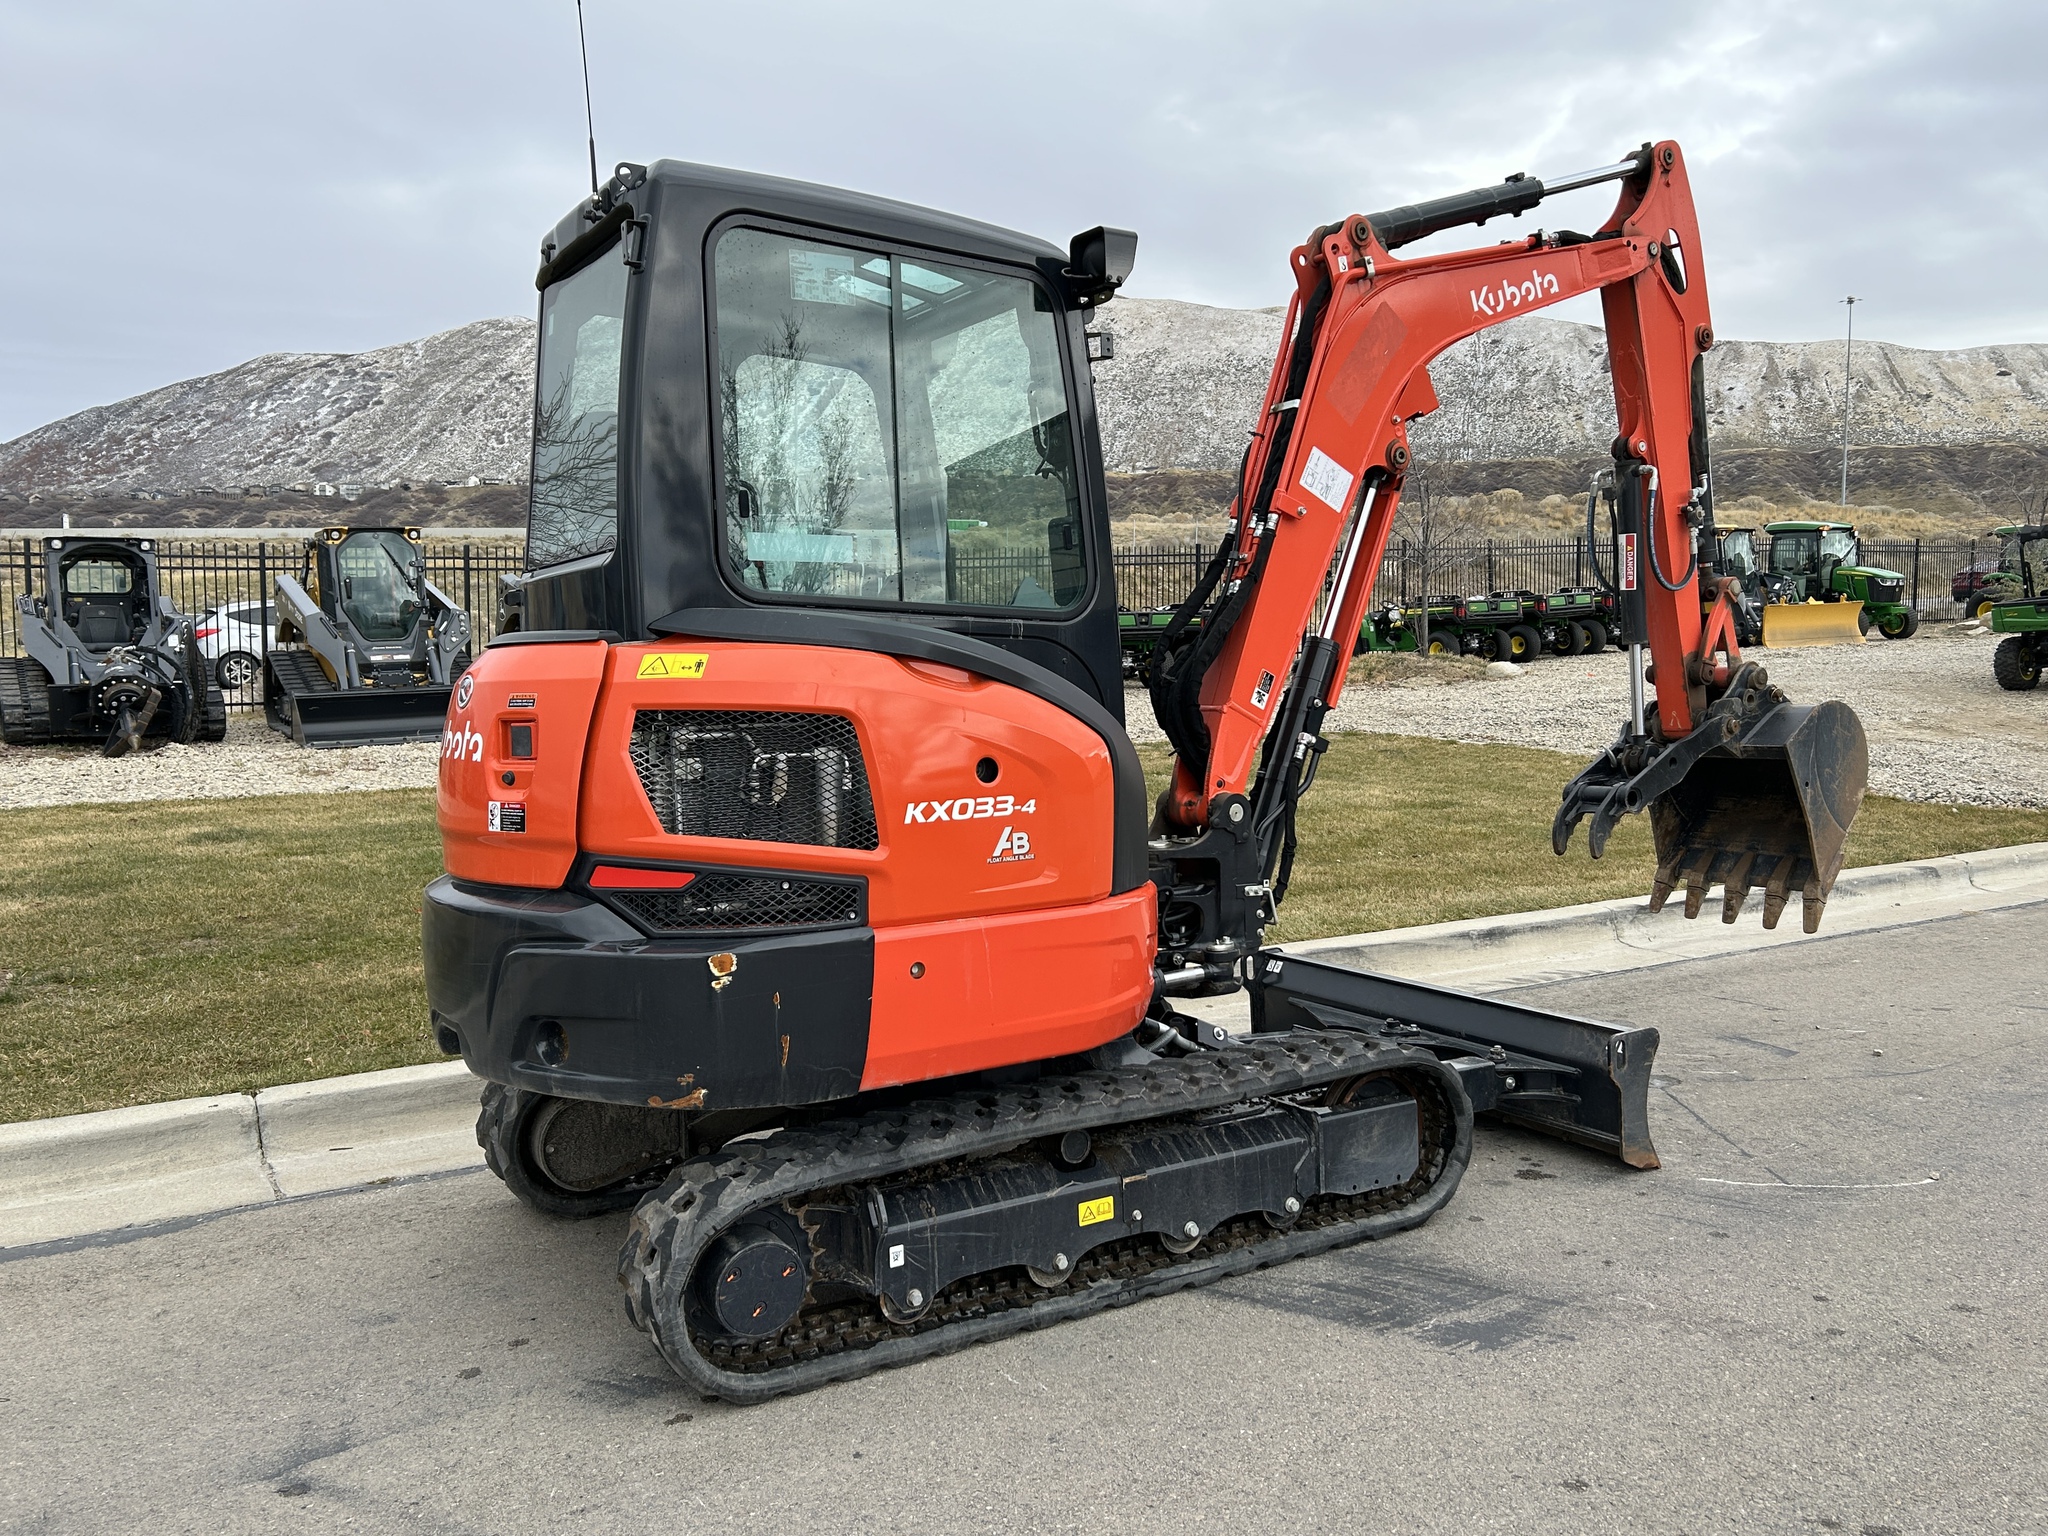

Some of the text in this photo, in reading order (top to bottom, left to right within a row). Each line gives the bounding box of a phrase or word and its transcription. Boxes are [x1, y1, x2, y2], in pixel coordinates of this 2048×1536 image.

[1469, 269, 1560, 316] Kubota
[1626, 551, 1634, 581] DANGER
[904, 795, 1036, 824] KX033-4
